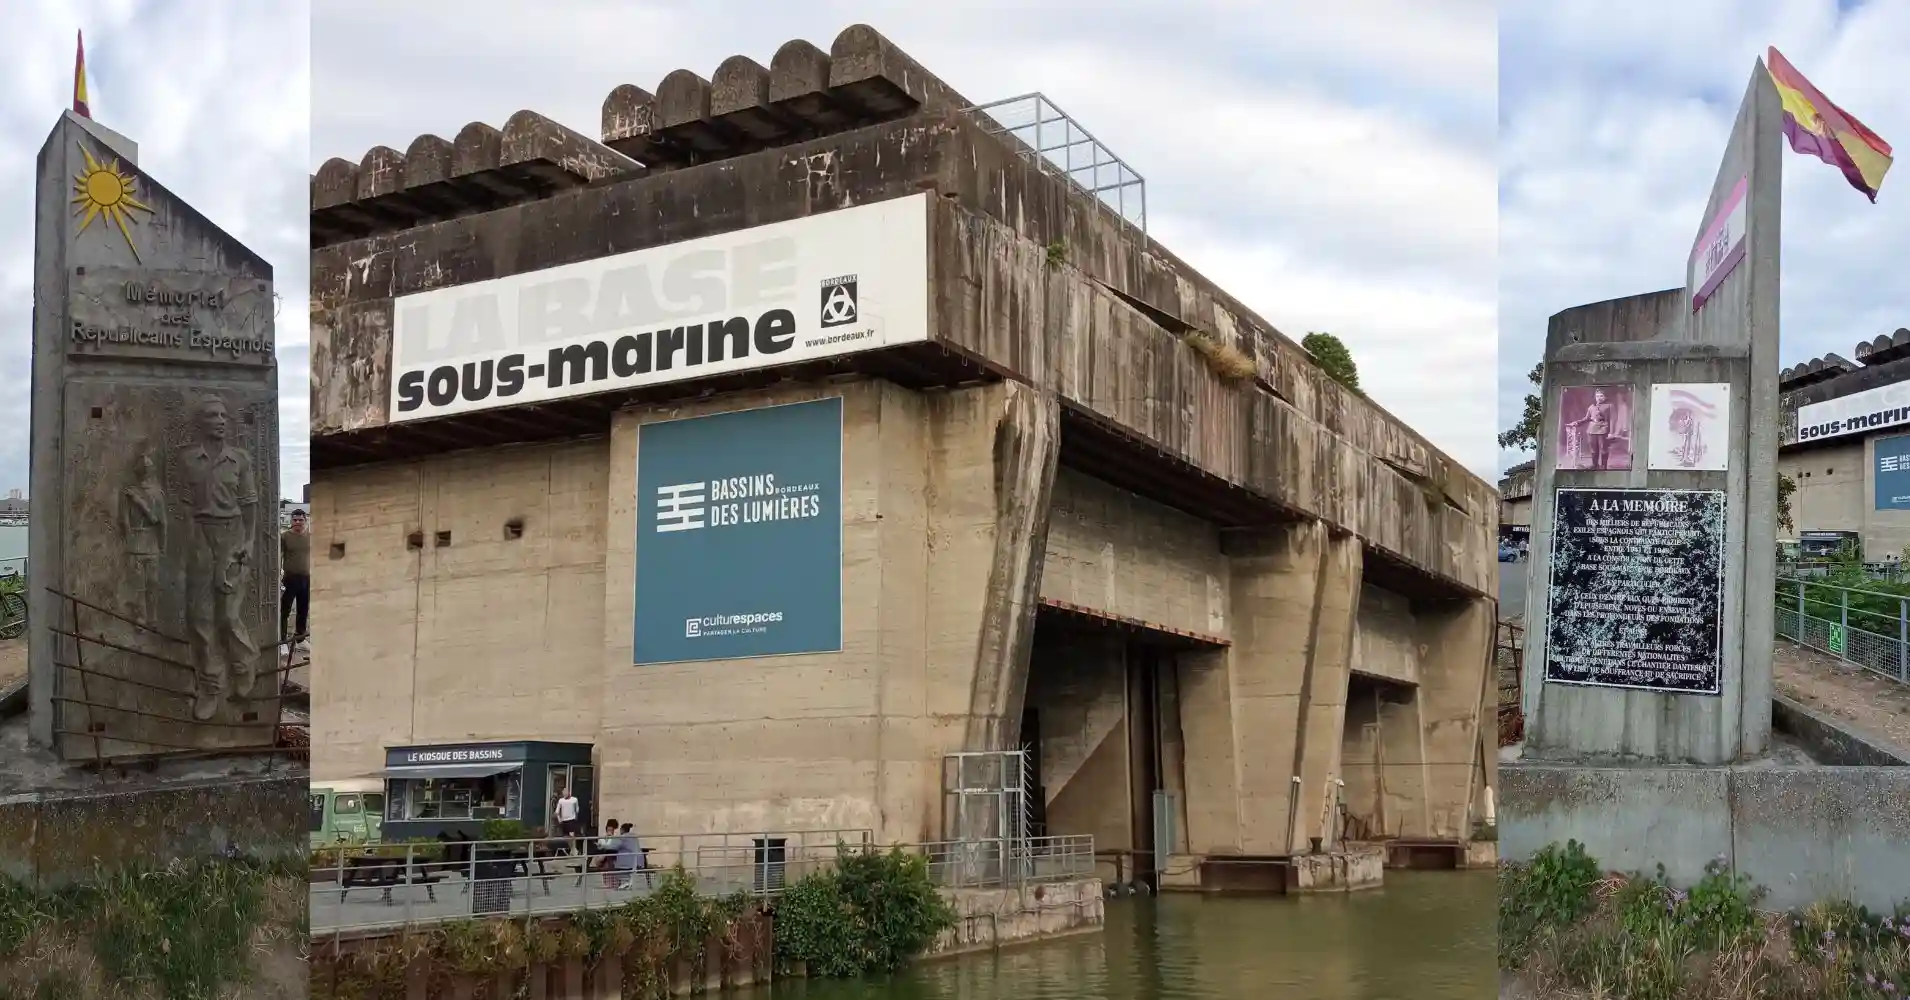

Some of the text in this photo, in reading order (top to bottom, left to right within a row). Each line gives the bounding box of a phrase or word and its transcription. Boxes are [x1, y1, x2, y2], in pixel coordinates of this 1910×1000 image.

[821, 275, 857, 287] BORDEAUX
[400, 235, 798, 366] LA BASE
[160, 311, 191, 325] des
[189, 328, 274, 358] Espagnols
[805, 327, 875, 349] www.bordeaux.fr
[397, 307, 796, 411] sous-marine
[711, 473, 775, 501] BASSINS
[775, 483, 820, 494] BORDEAUX
[711, 494, 820, 527] DES LUMIÈRES
[1603, 499, 1619, 512] LA
[1622, 499, 1689, 513] MEMOIRE
[703, 611, 783, 628] culturespaces
[407, 749, 503, 762] LE KIOSQUE DES BASSINS
